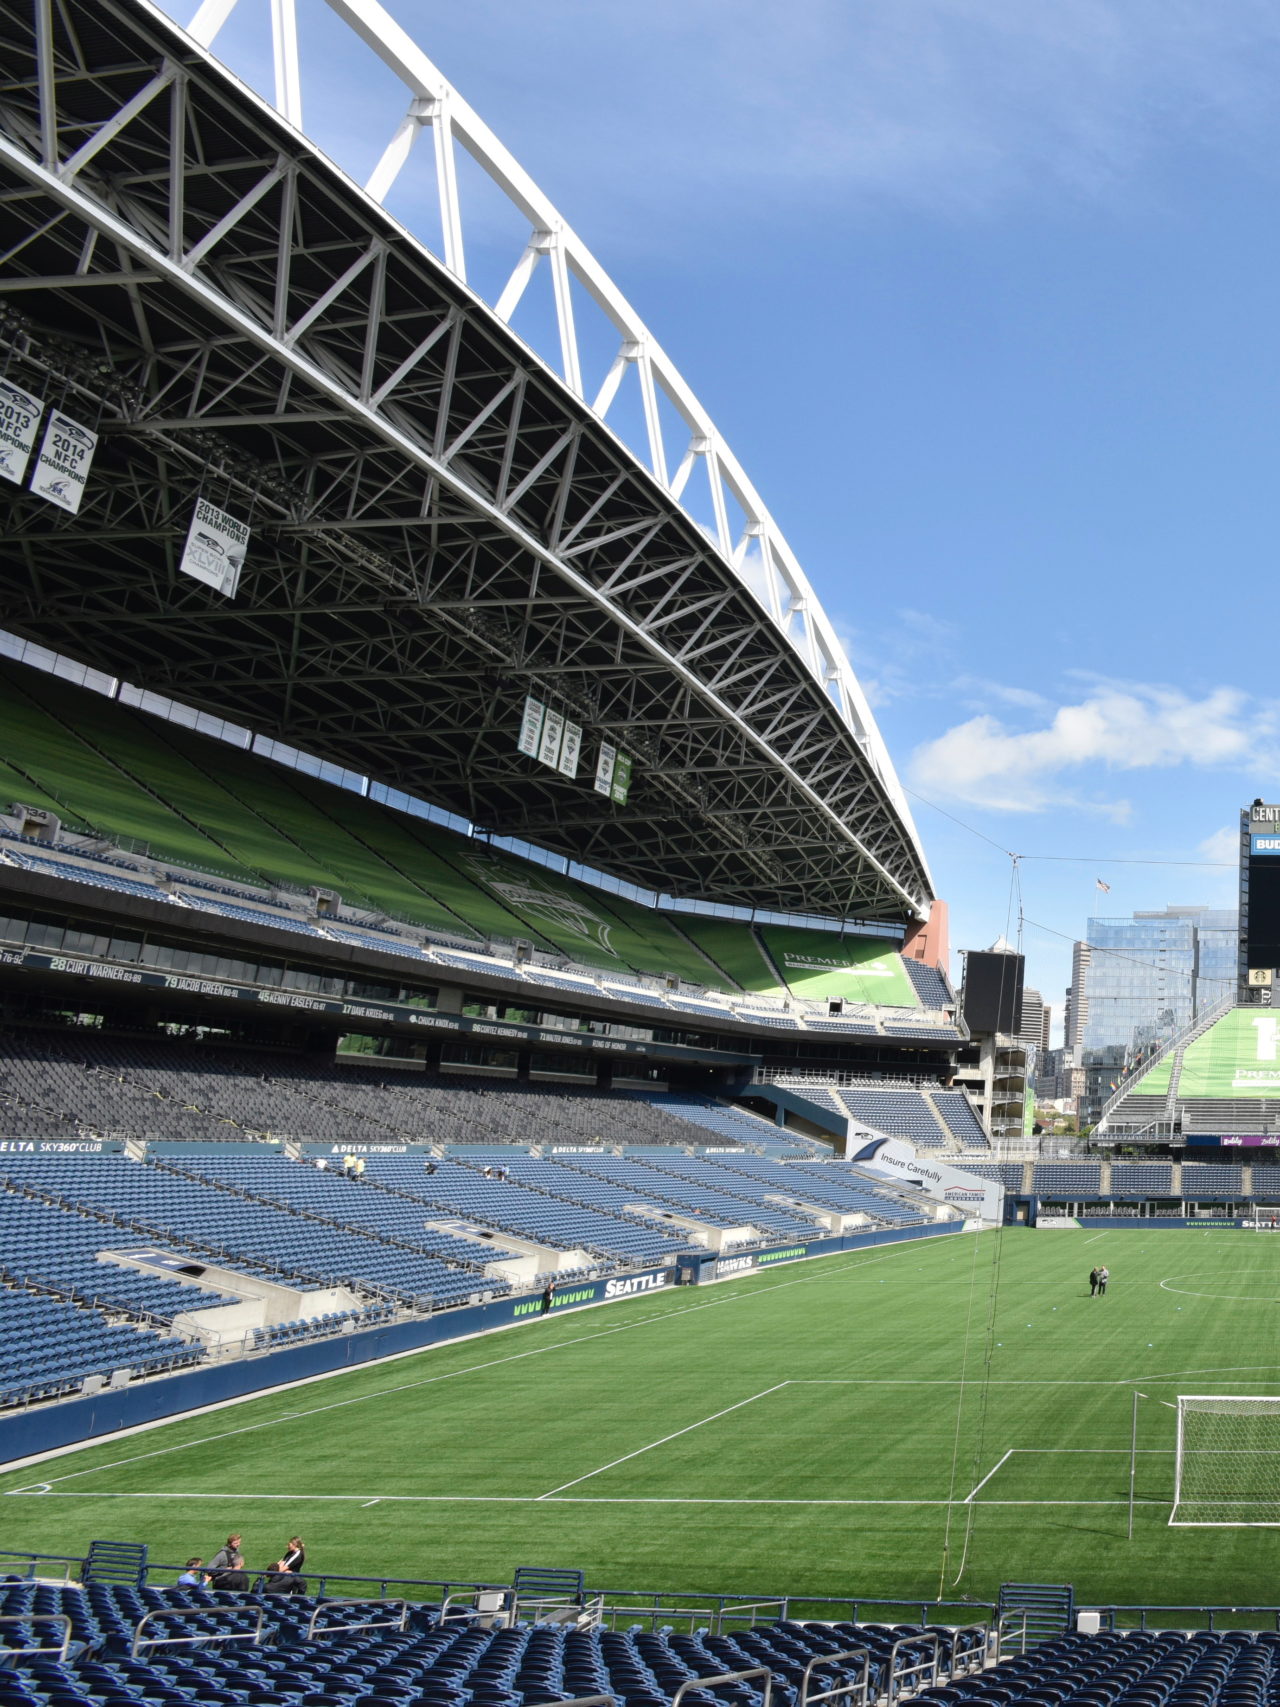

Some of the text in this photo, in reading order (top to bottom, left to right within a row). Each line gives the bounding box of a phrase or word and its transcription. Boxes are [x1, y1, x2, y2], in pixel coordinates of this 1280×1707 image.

[0, 401, 31, 429] 2013
[0, 430, 31, 454] MPIONS
[52, 433, 86, 461] 2014
[40, 453, 86, 485] CHAMPIONS
[54, 448, 79, 469] NFC
[196, 510, 246, 545] CHAMPIONS
[199, 501, 249, 537] 2013 WORLD
[49, 957, 66, 971] 28
[65, 959, 88, 975] CURT
[89, 964, 124, 980] WARNER
[783, 952, 861, 968] PREMERA
[164, 976, 178, 989] 79
[176, 978, 200, 992] JACOB
[200, 982, 224, 996] GREEN
[257, 990, 270, 1002] 45
[269, 991, 290, 1006] KENNY
[290, 996, 314, 1010] EASLEY
[341, 1003, 352, 1014] 17
[350, 1005, 366, 1017] DAVE
[417, 1015, 435, 1027] CHUCK
[591, 1039, 627, 1051] RING OF HONOR
[0, 1142, 34, 1152] ELTA
[340, 1144, 368, 1153] DELTA
[880, 1152, 943, 1184] Insure Carefully
[716, 1255, 753, 1274] HAWKS
[604, 1272, 665, 1299] SEATTLE
